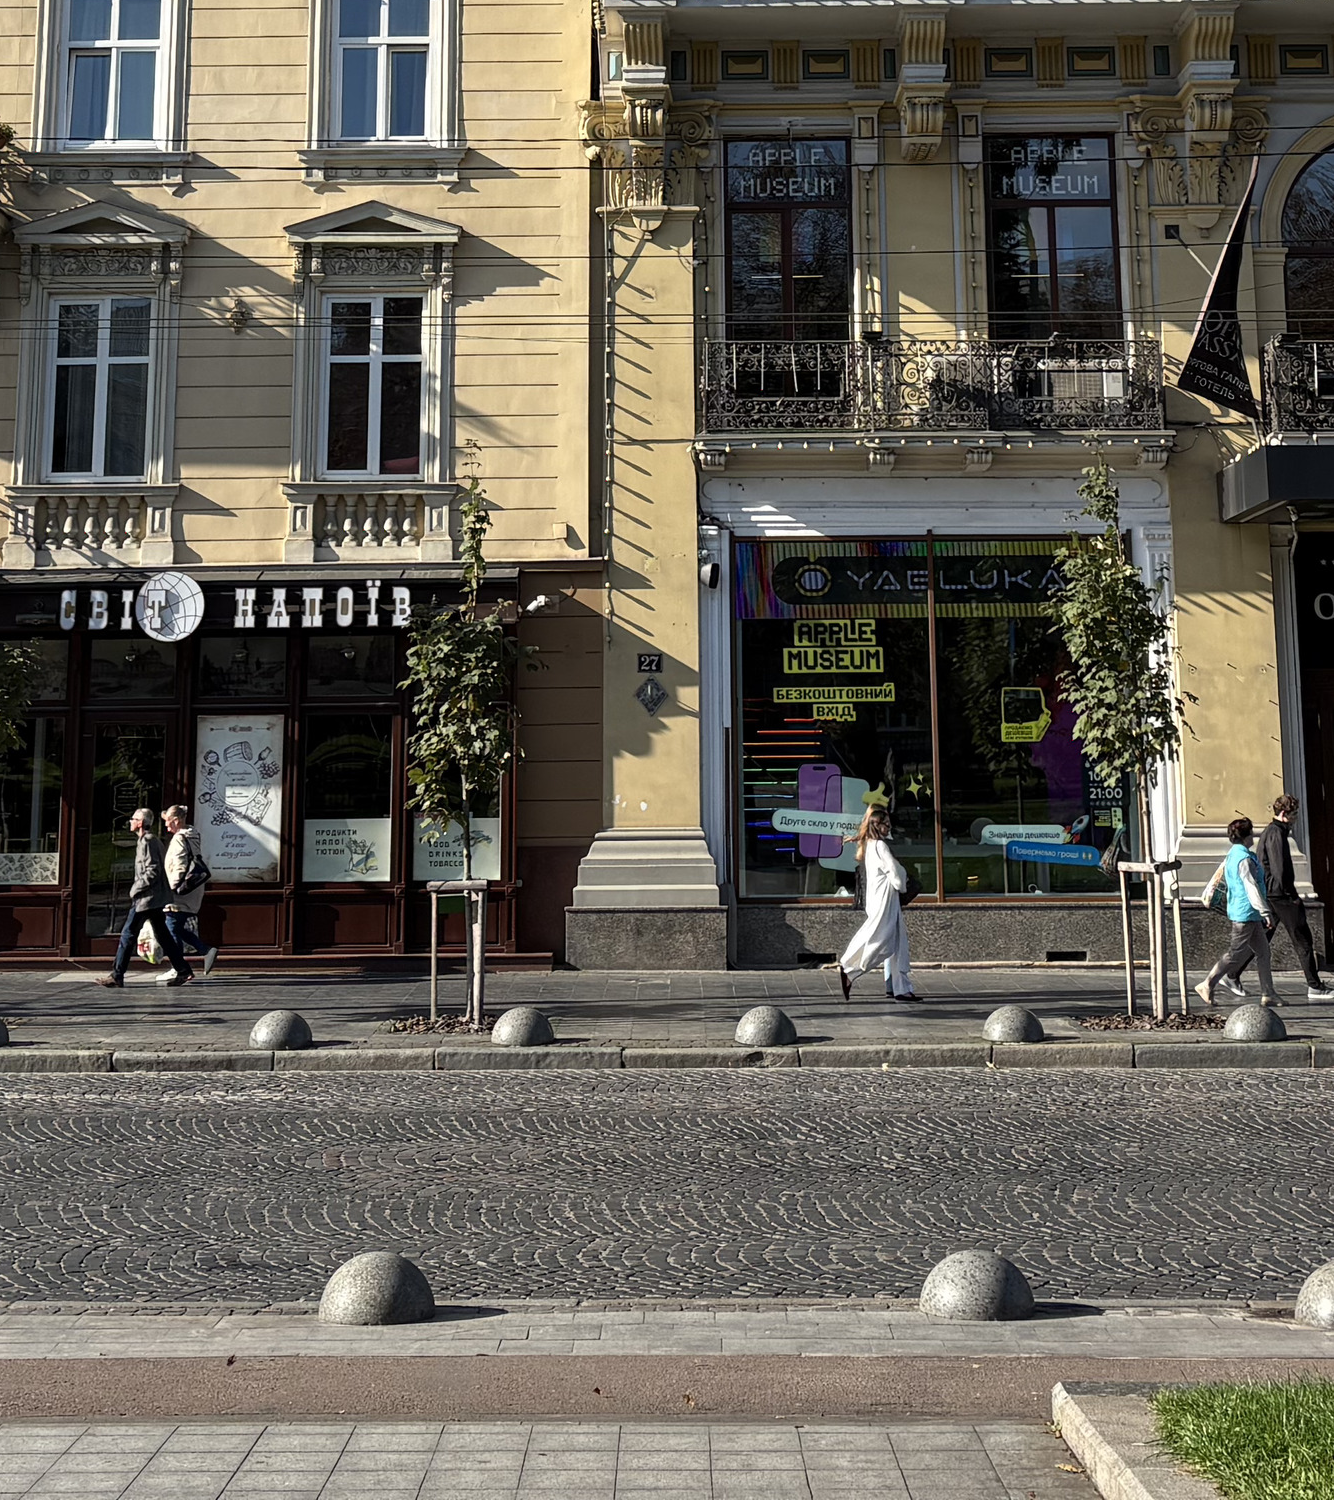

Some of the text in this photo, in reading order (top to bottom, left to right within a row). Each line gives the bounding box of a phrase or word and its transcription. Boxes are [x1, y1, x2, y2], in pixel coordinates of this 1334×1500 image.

[749, 148, 825, 167] APPLE
[1011, 146, 1087, 165] APPLE
[740, 177, 835, 197] MUSEUM
[1002, 175, 1098, 194] MUSEUM
[1194, 375, 1235, 400] ГОТЕЛЬ
[60, 580, 412, 630] СВІТ НАПОЇВ
[798, 622, 872, 643] APPLE
[641, 655, 659, 670] 27
[787, 649, 881, 670] MUSEUM
[776, 684, 893, 700] БЕЗКОШТОВНИЙ
[816, 706, 854, 719] ВХІД
[1089, 788, 1123, 799] 21:00
[780, 816, 806, 827] Друге
[807, 818, 828, 828] скло
[1012, 846, 1079, 859] Повернемо гроші
